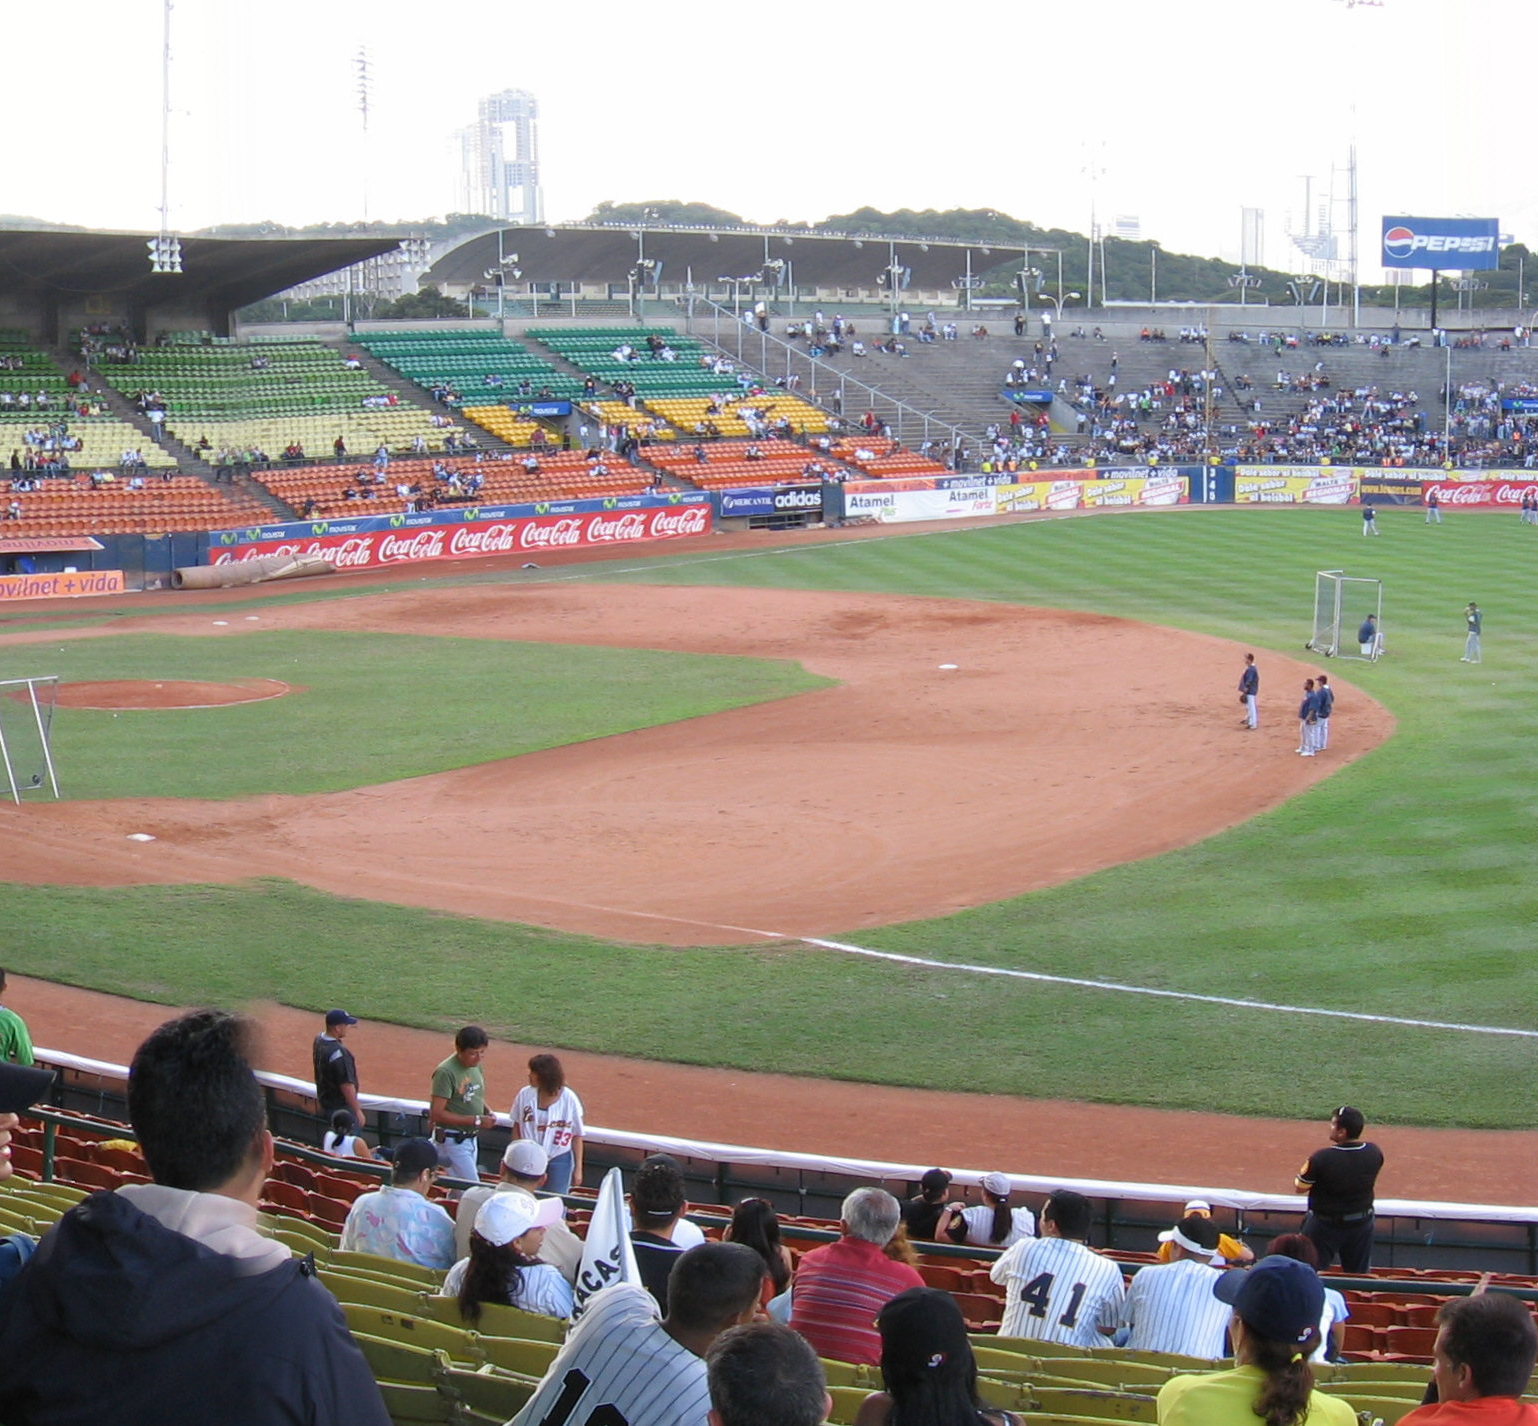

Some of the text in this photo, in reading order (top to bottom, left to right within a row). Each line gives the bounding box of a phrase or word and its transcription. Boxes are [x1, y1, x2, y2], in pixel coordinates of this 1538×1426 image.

[1111, 466, 1179, 479] movilnet vida
[774, 489, 822, 509] adidas
[948, 488, 989, 502] Atamel
[1305, 484, 1354, 499] REGIONAL
[849, 494, 895, 509] Atamel
[79, 571, 119, 593] vida
[552, 1129, 571, 1146] 23
[1020, 1272, 1087, 1328] 41
